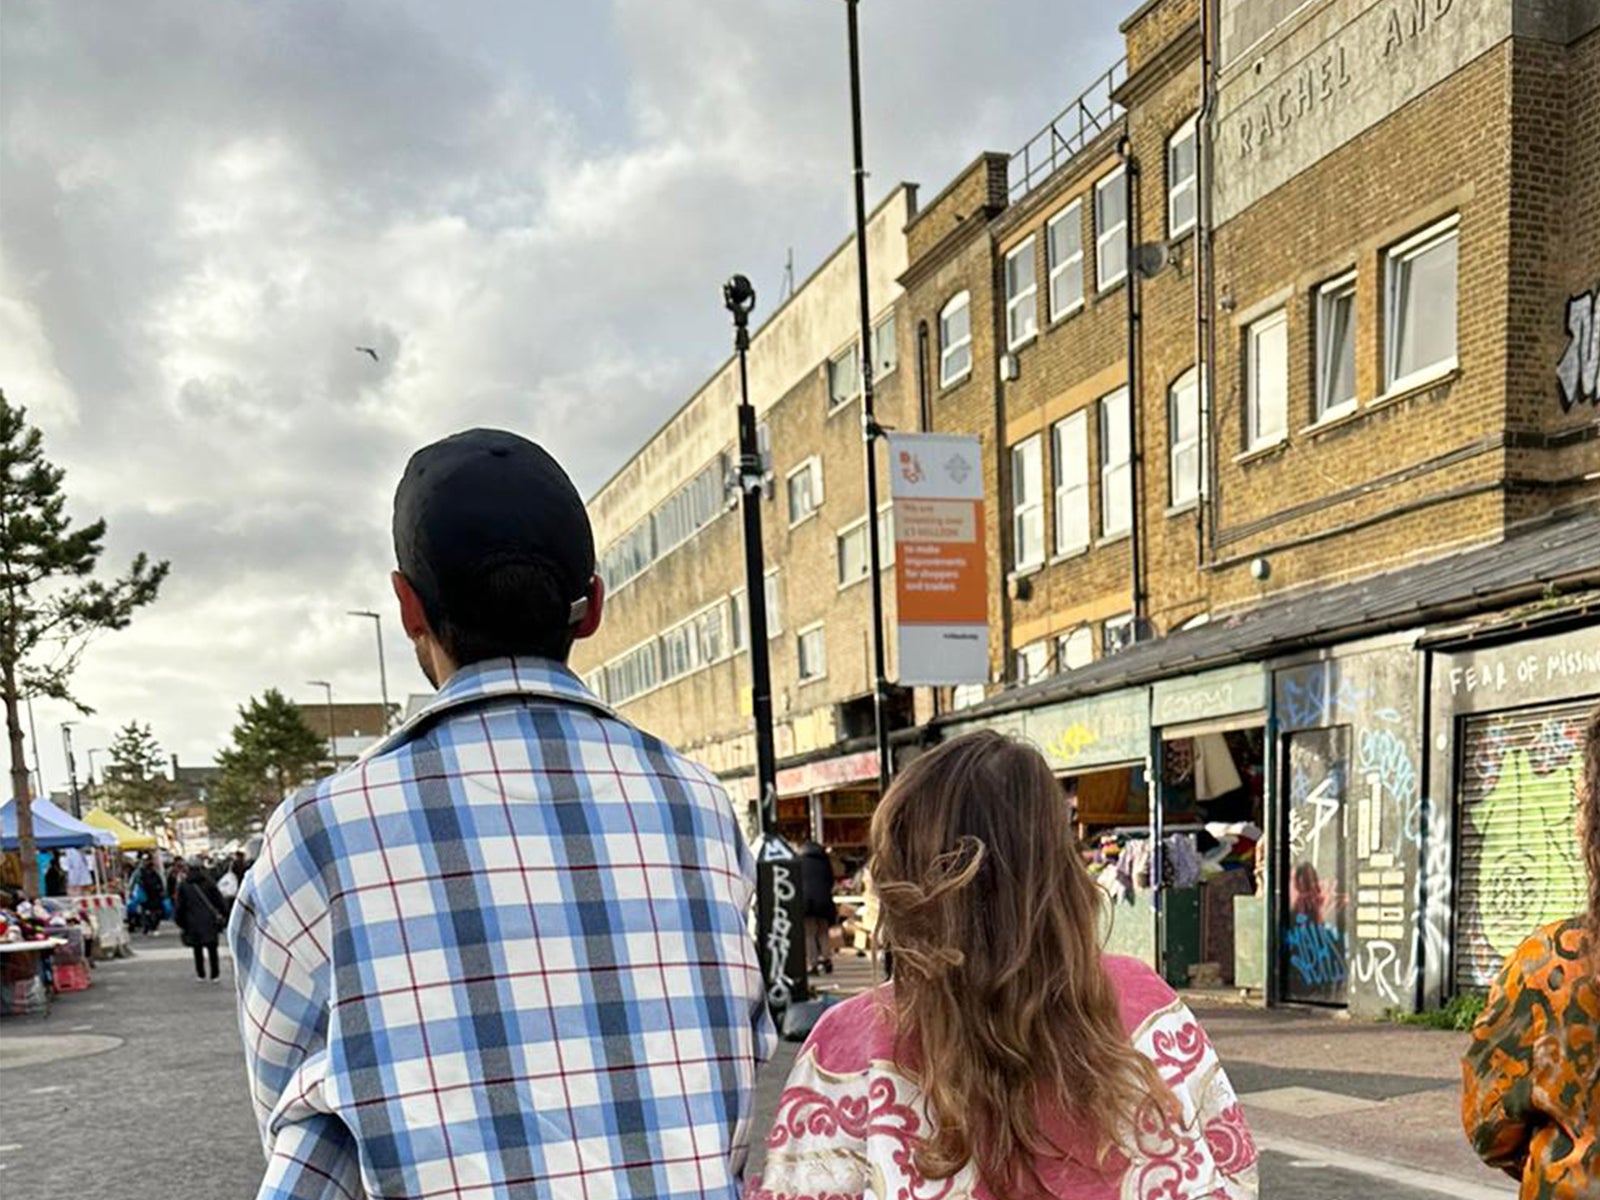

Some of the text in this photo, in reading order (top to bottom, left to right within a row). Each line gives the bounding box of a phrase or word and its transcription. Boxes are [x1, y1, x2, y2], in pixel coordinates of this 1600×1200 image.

[1239, 47, 1351, 158] RACHEL
[1448, 649, 1600, 696] FEAR OF MISSIN
